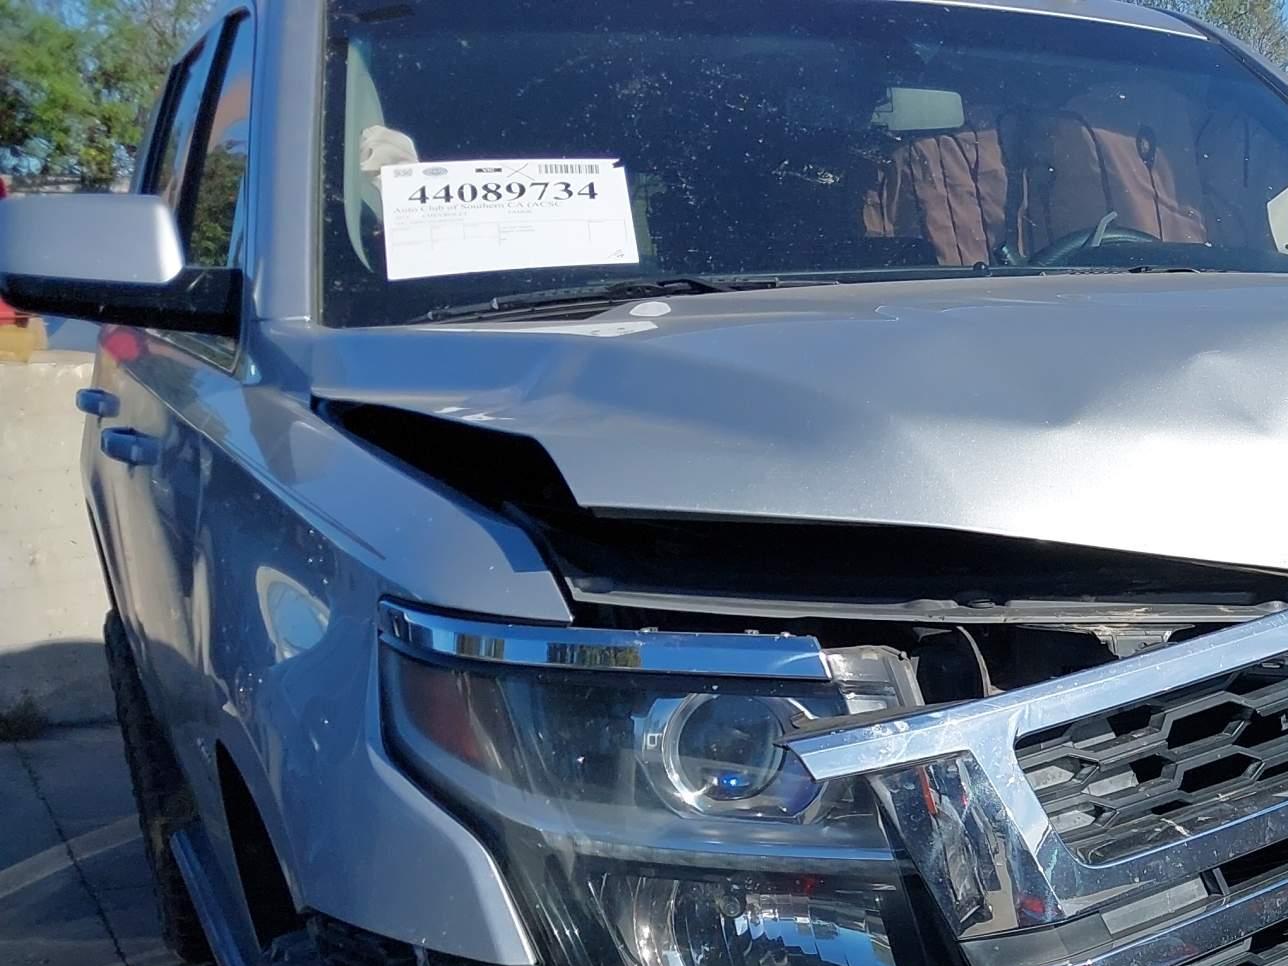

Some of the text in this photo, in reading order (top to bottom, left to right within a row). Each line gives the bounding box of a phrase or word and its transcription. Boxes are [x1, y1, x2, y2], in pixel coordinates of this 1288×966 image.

[408, 181, 598, 204] 44089734
[420, 204, 444, 212] Club
[460, 201, 505, 210] Southern
